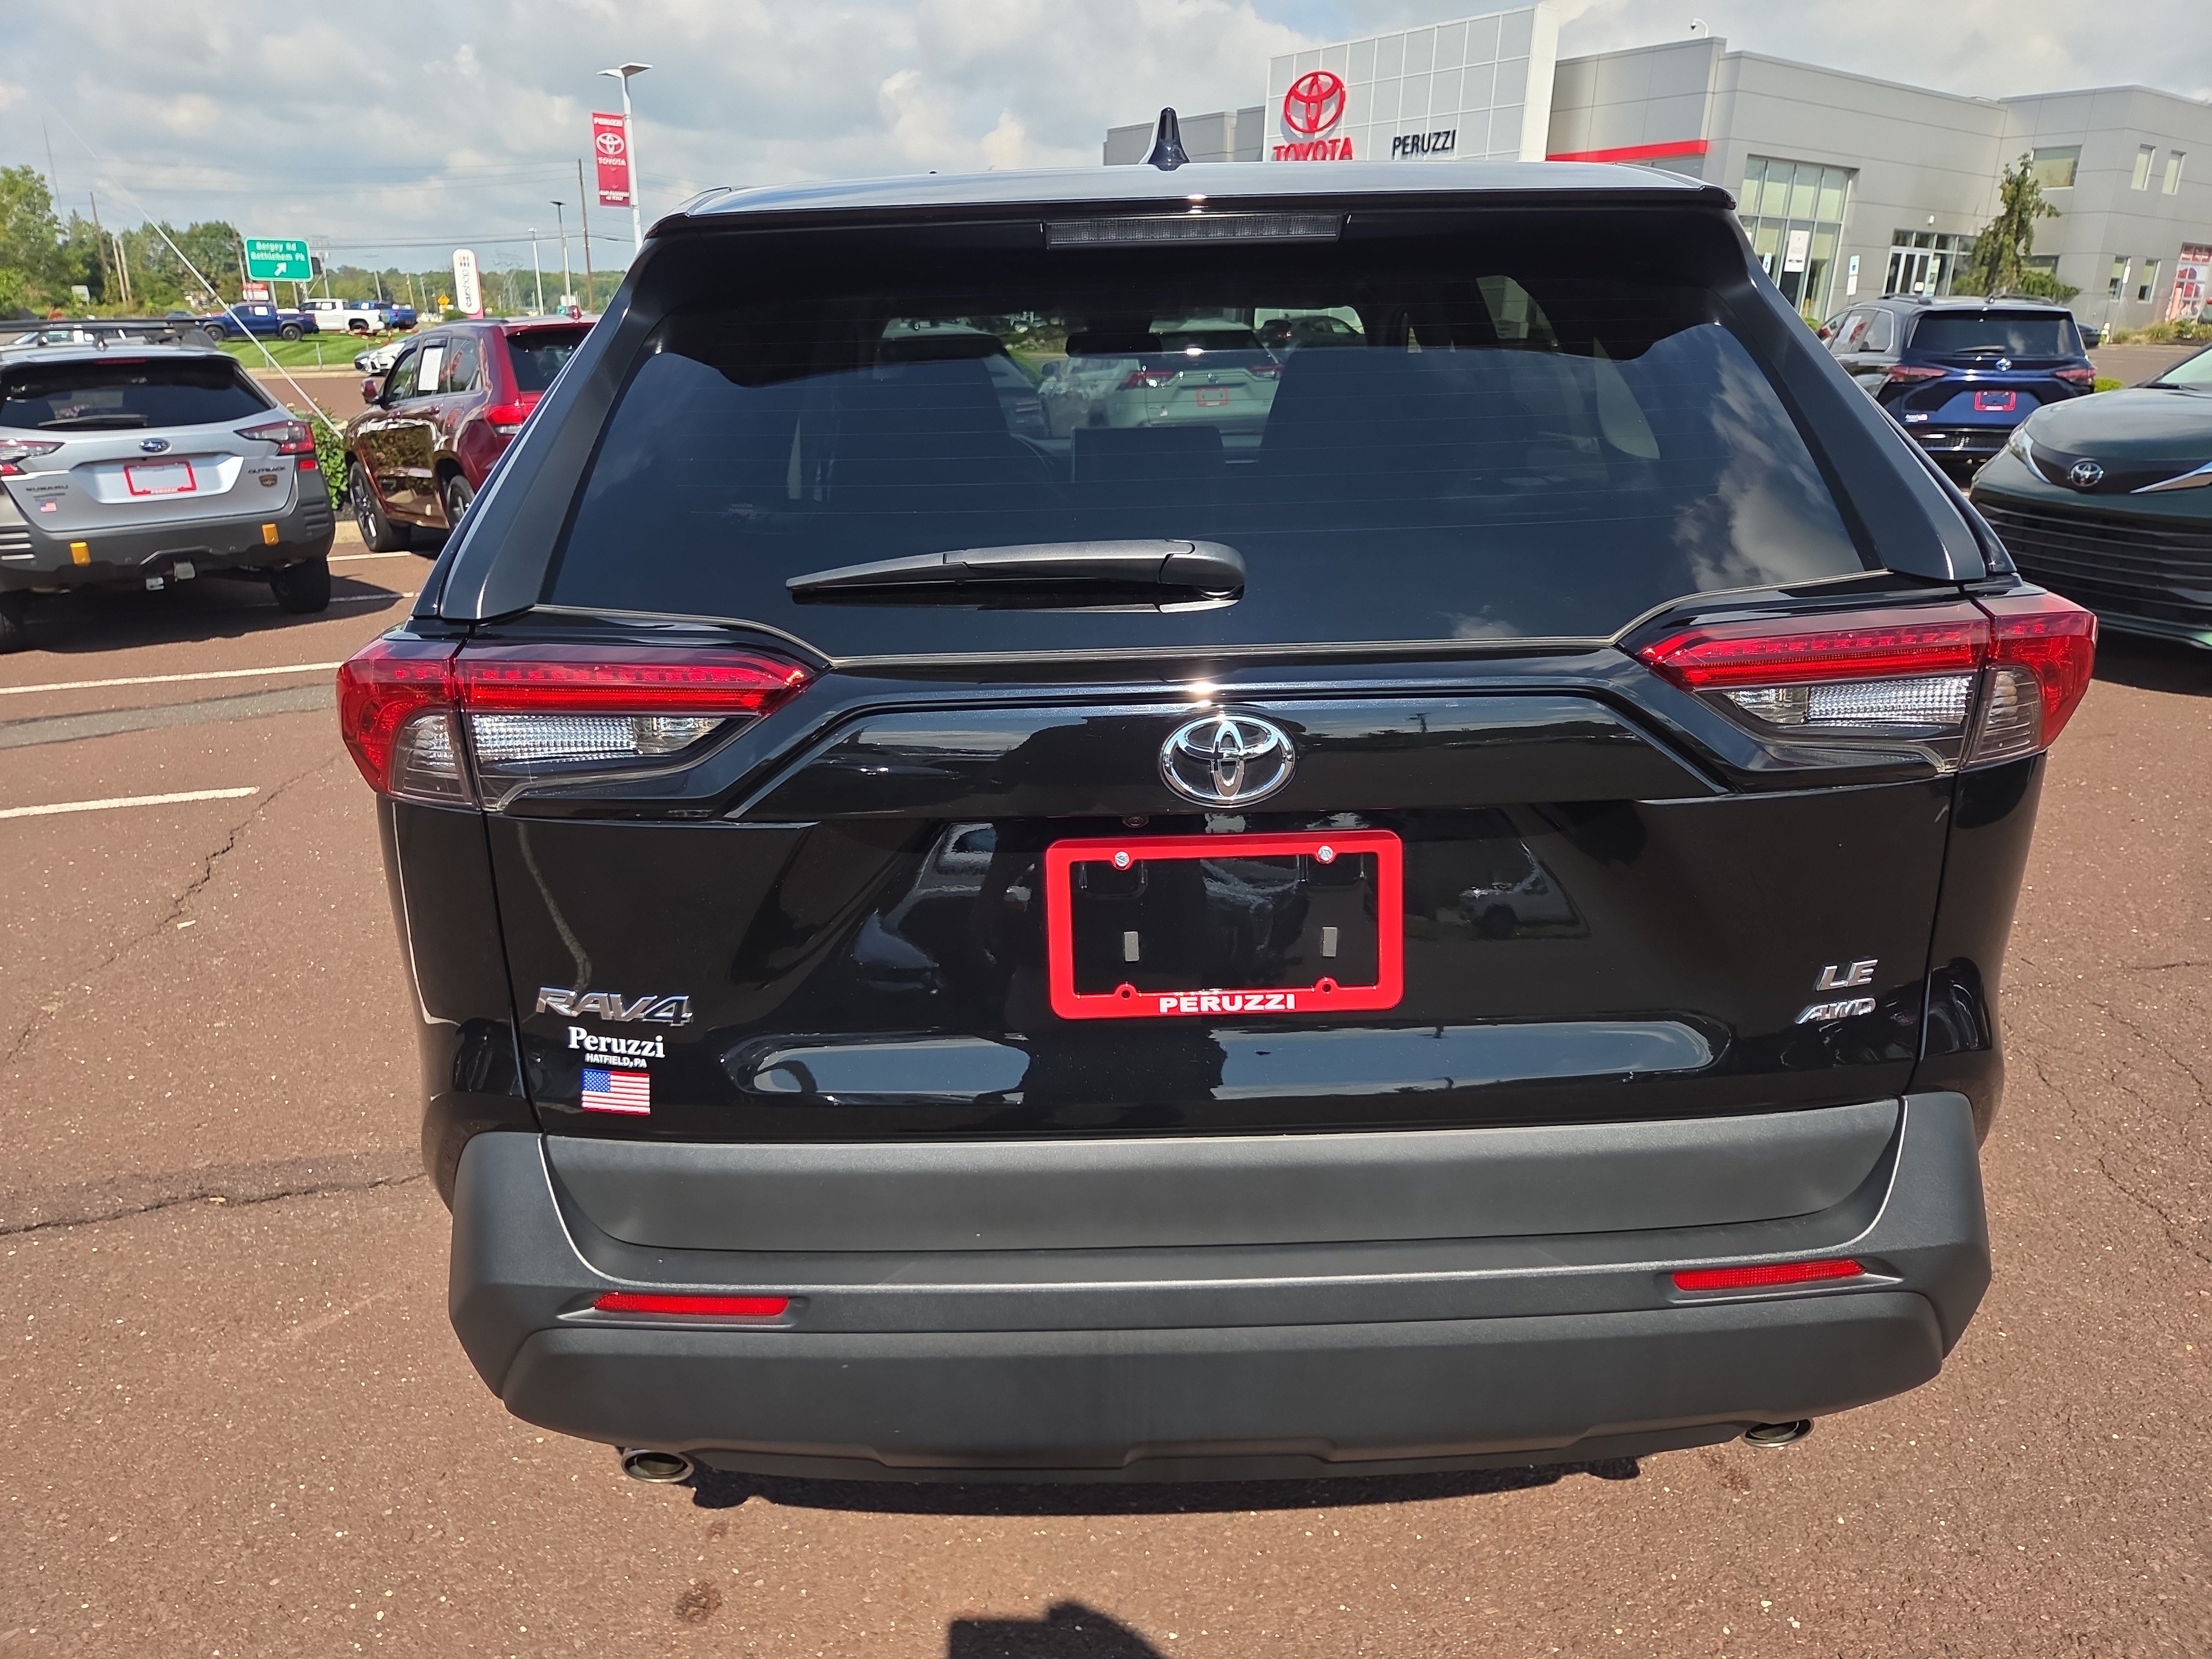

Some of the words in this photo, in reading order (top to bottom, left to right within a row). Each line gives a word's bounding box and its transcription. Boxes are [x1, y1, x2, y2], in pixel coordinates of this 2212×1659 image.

[1272, 137, 1353, 160] TOYOTA
[1392, 130, 1457, 156] PERUZZI
[597, 157, 626, 166] TOYOTA
[250, 251, 293, 261] Bethlehem
[256, 241, 284, 253] Bergey
[285, 242, 297, 252] Rd
[1815, 959, 1879, 992] LE
[536, 987, 694, 1026] RAV4
[1159, 994, 1295, 1013] PERUZZI
[1795, 998, 1876, 1024] AWD
[567, 1026, 666, 1058] Peruzzi
